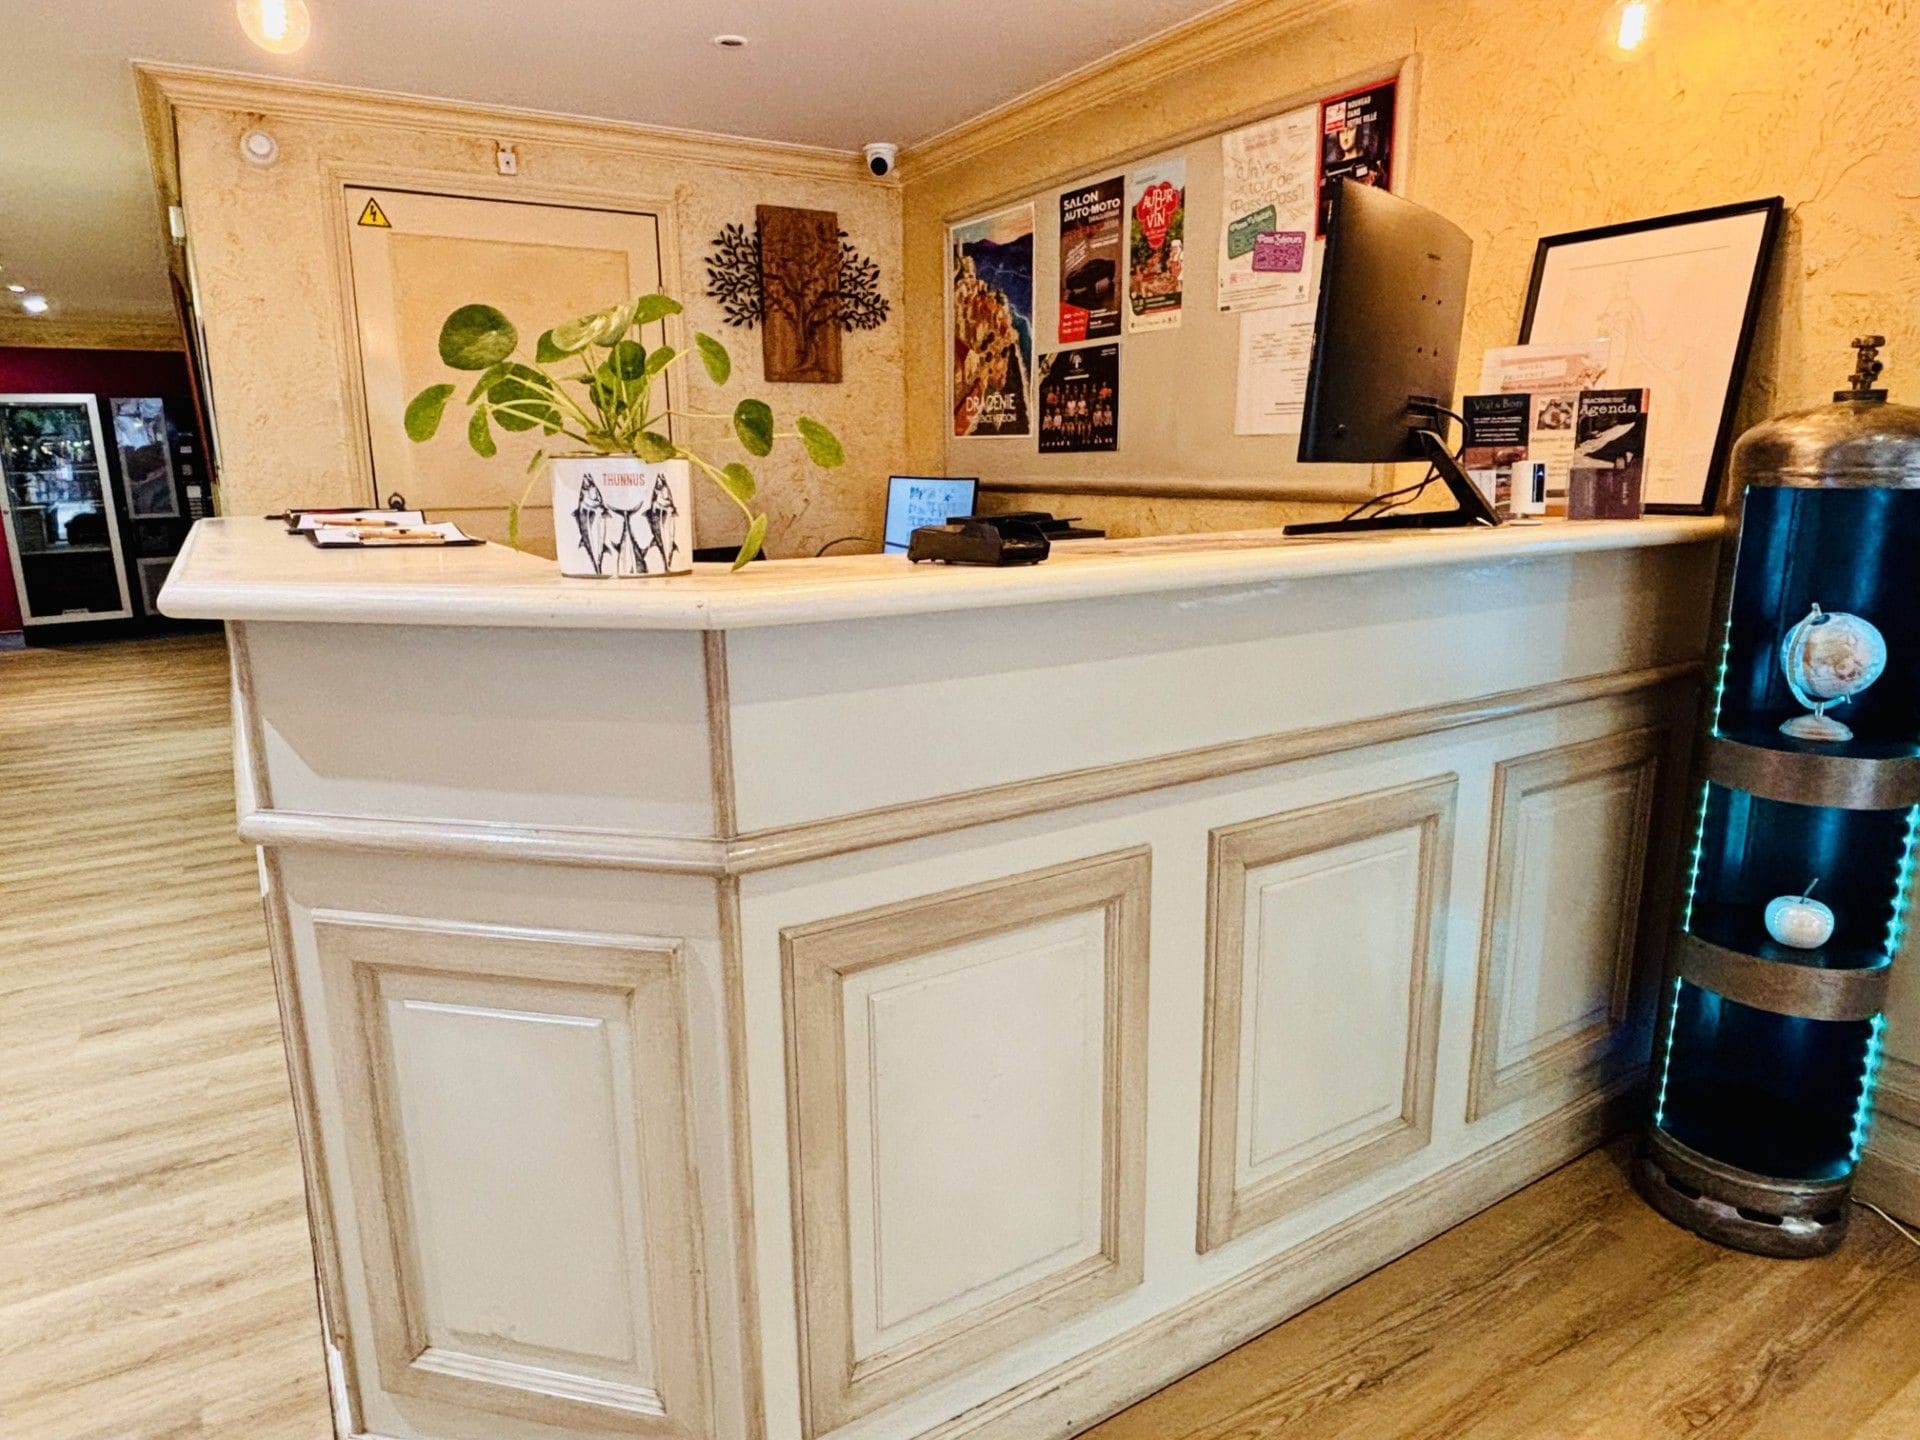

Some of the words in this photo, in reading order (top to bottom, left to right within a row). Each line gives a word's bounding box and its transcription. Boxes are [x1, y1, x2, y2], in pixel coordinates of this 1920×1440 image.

[1064, 190, 1099, 211] SALON
[1579, 403, 1638, 417] Agenda
[602, 472, 646, 487] THUNNUS
